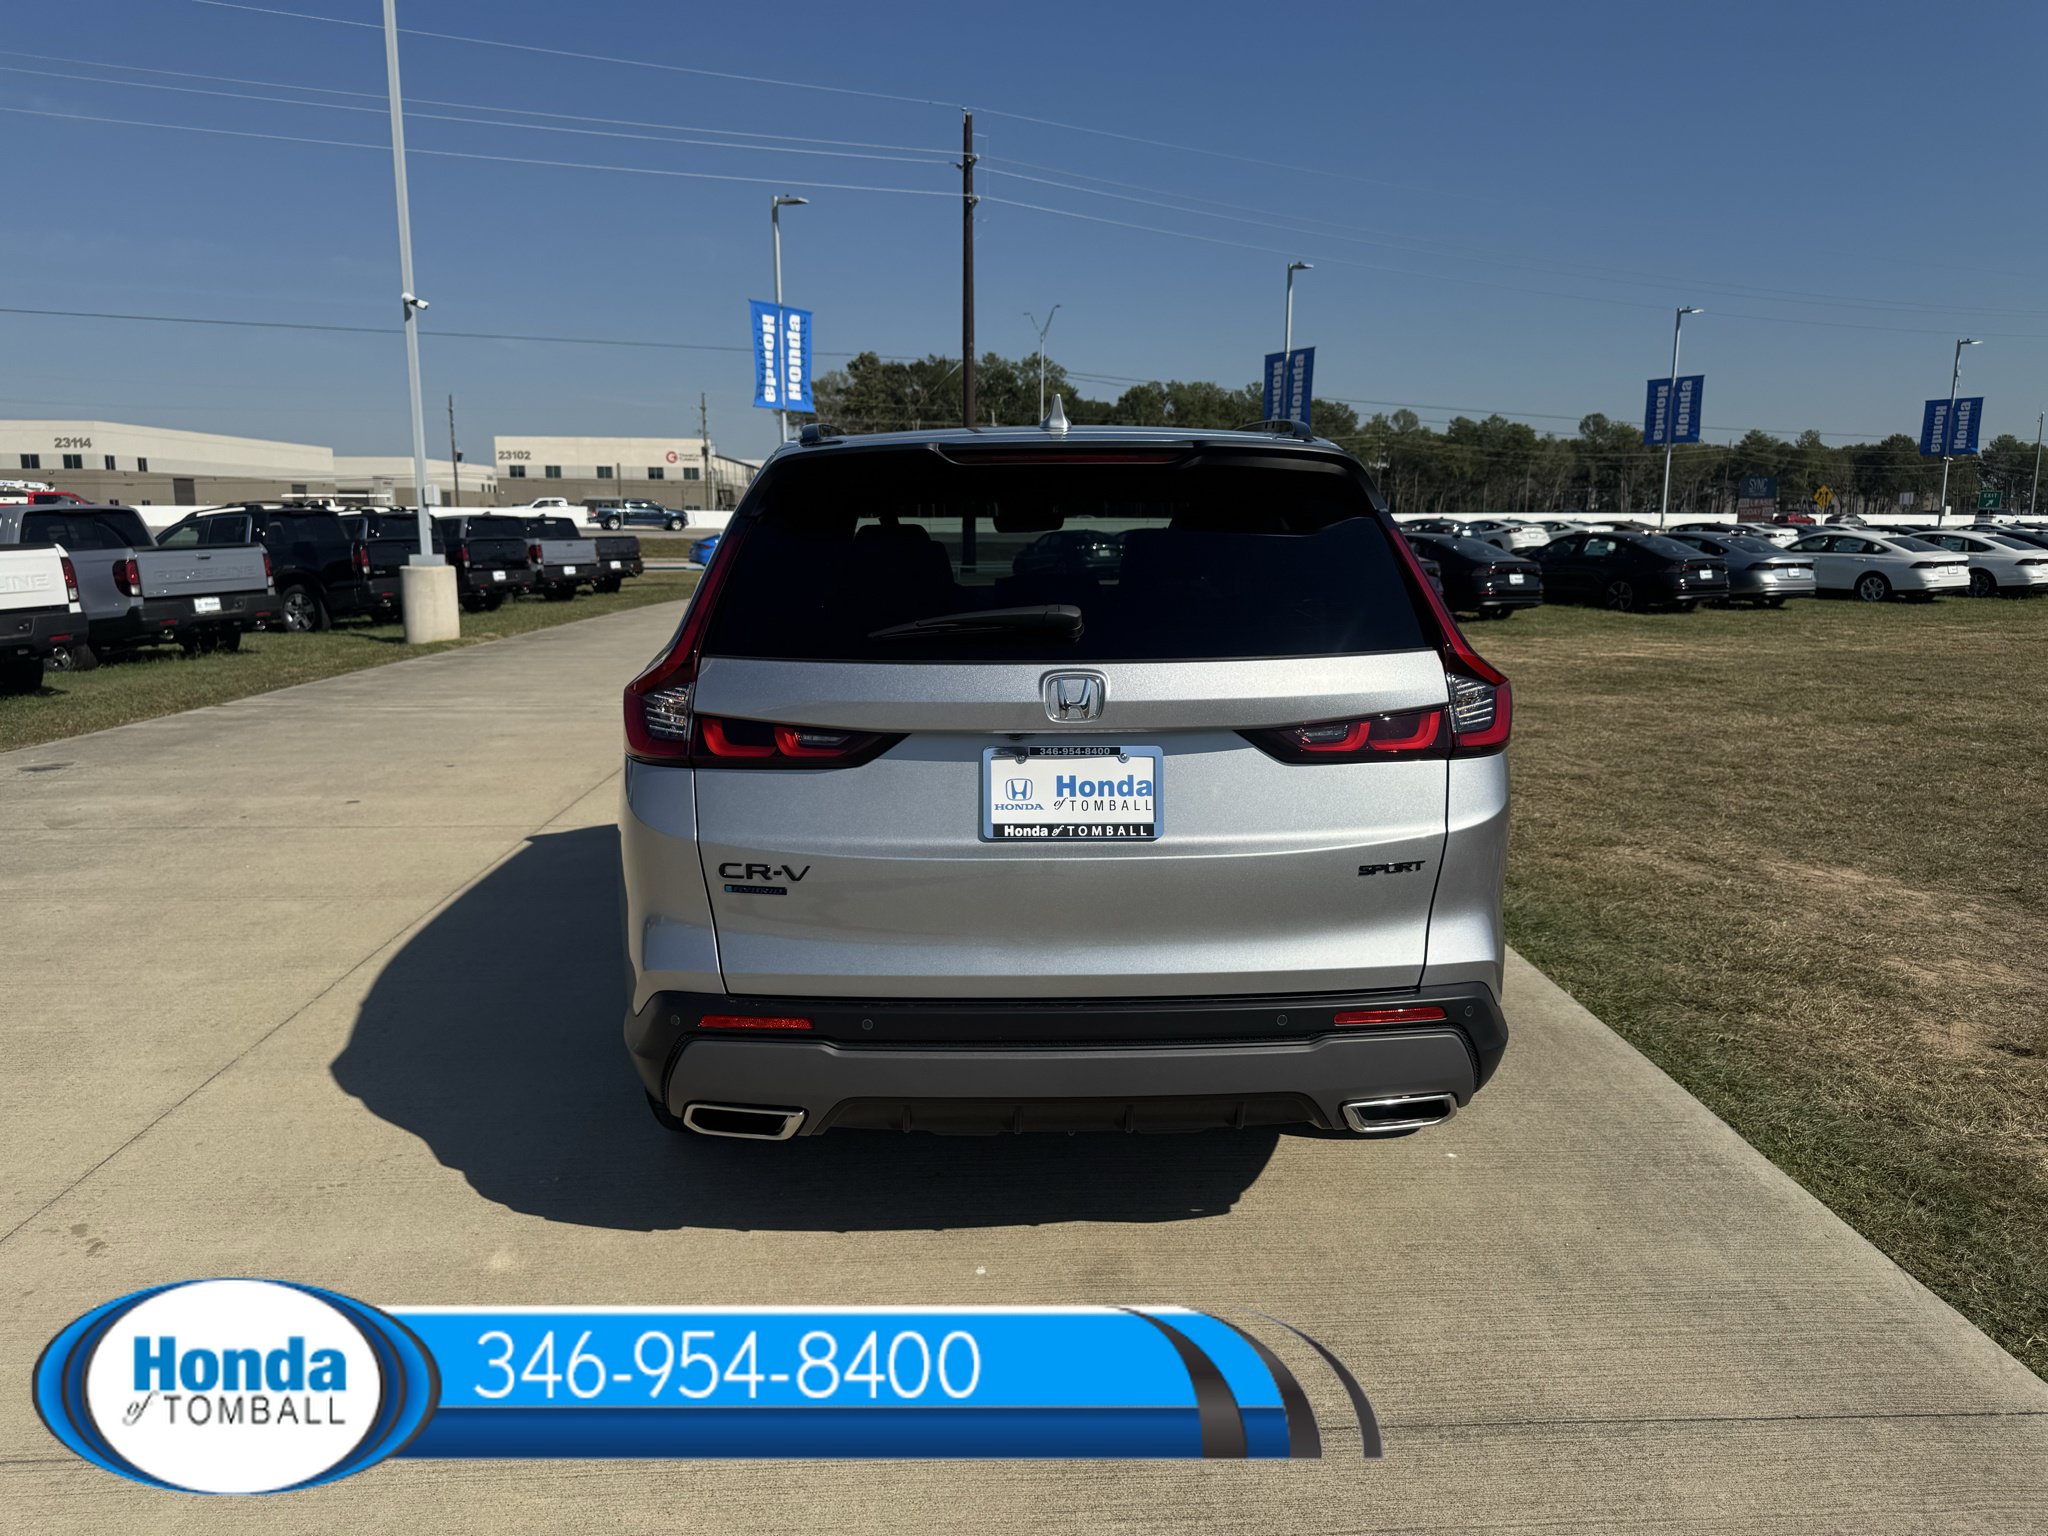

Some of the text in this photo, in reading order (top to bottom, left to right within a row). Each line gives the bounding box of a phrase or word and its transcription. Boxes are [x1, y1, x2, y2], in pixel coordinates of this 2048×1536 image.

[762, 314, 776, 402] Honda
[787, 314, 802, 400] Honda
[1653, 385, 1669, 440] Honda
[1675, 380, 1693, 436] Honda
[1930, 405, 1948, 453] Honda
[1953, 401, 1972, 449] Honda
[53, 437, 92, 448] 23114
[498, 450, 531, 460] 23102
[1749, 478, 1769, 490] SYNC
[1056, 774, 1153, 797] Honda
[994, 803, 1044, 811] HONDA
[1053, 797, 1152, 811] of TOMBALL
[1004, 825, 1147, 837] Honda of TOMBALL
[718, 862, 811, 882] CR-V
[1358, 860, 1426, 876] SPORT
